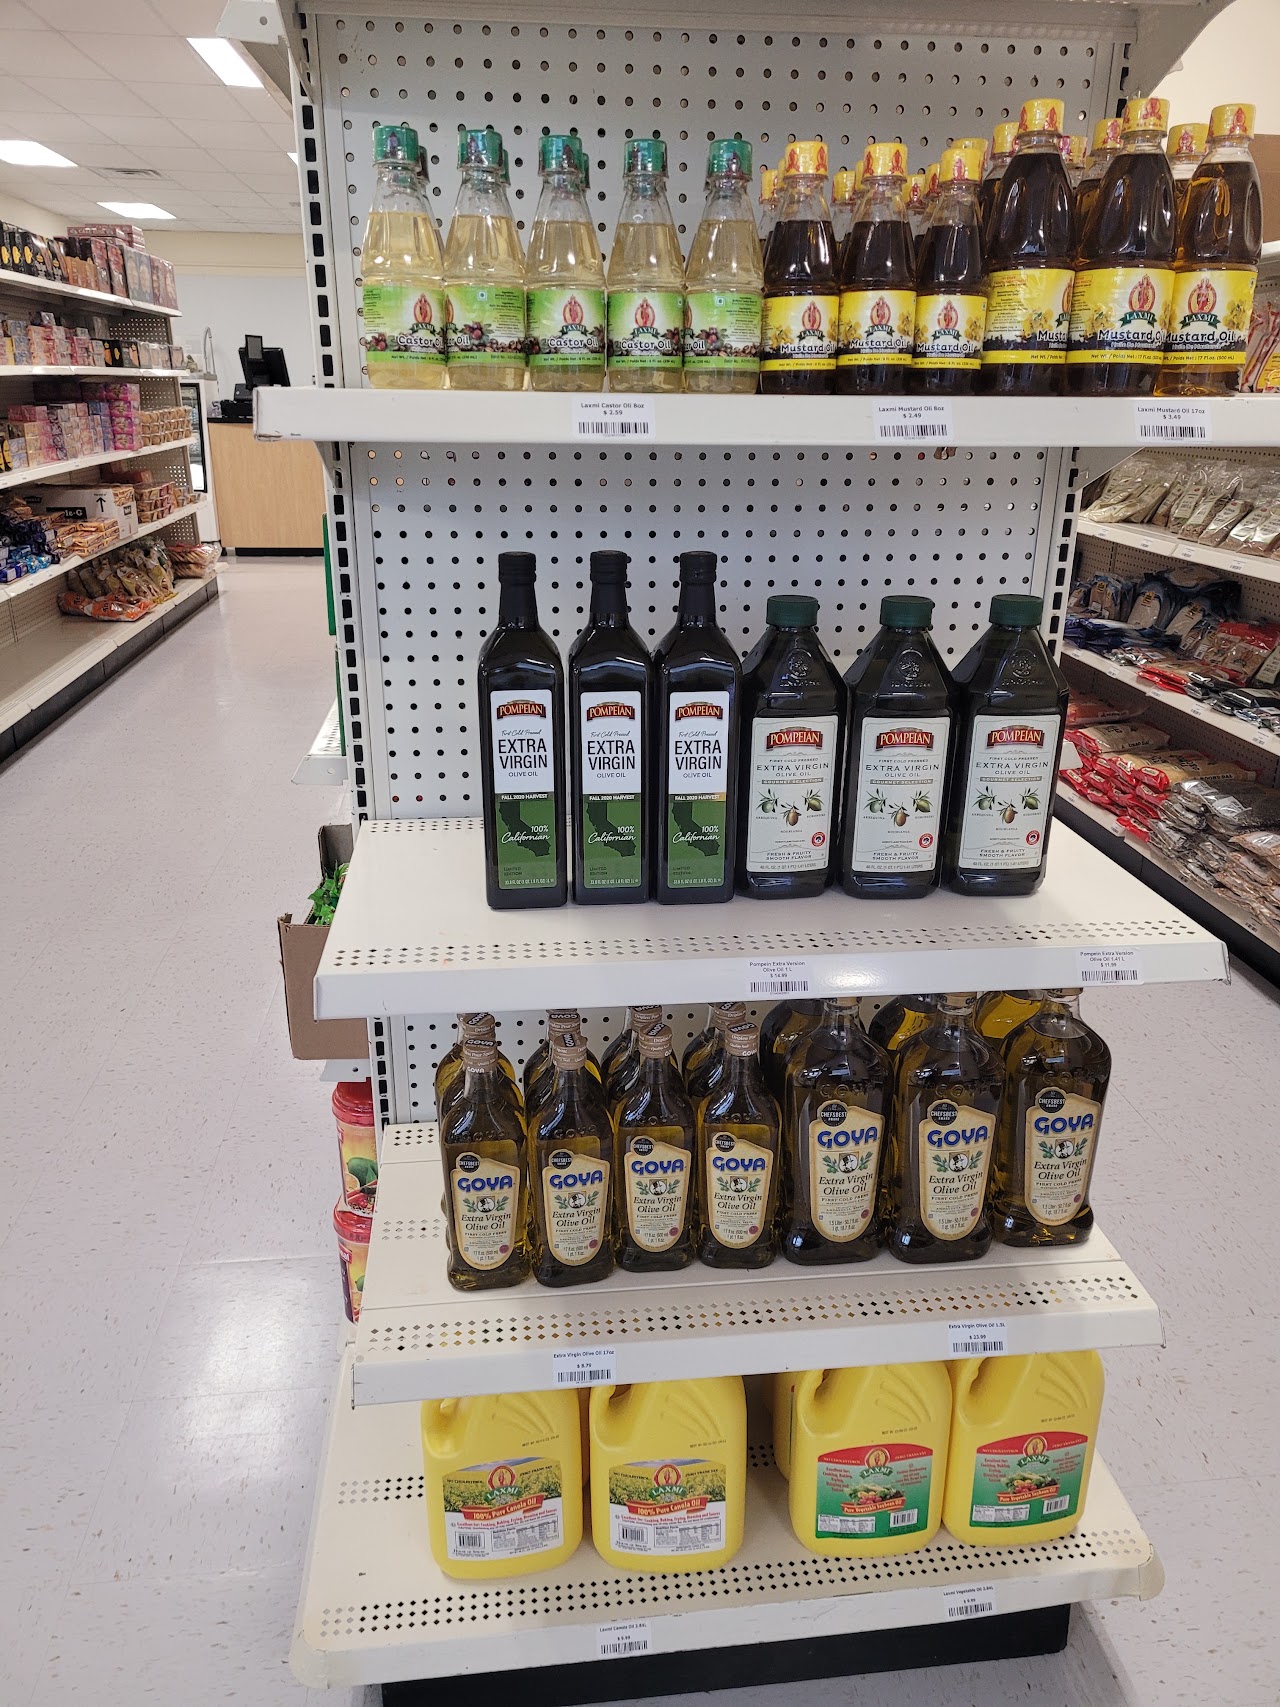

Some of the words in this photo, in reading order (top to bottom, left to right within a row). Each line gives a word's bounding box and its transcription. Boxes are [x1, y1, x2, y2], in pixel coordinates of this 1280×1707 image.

[1126, 312, 1154, 321] LAXMI
[1185, 314, 1215, 323] LAXMI
[413, 323, 434, 332] LAXMI
[562, 324, 585, 332] LAXMI
[634, 327, 657, 335] LAXMI
[869, 325, 891, 333] LAXMI
[936, 329, 958, 337] LAXMI
[801, 330, 822, 338] LAXMI
[1098, 329, 1153, 341] Mustard
[1219, 330, 1235, 342] Oil
[398, 335, 433, 347] Castor
[456, 335, 471, 346] Oil
[549, 337, 584, 348] Castor
[586, 337, 598, 348] Oil
[621, 340, 655, 350] Castor
[657, 340, 671, 350] Oil
[692, 340, 705, 350] Oil
[850, 338, 893, 348] Mustard
[895, 338, 907, 348] Oil
[781, 343, 824, 353] Mustard
[917, 343, 959, 352] Mustard
[961, 343, 975, 352] Oil
[499, 703, 543, 716] POMPEIAN
[589, 705, 632, 717] POMPEIAN
[678, 705, 721, 717] POMPEIAN
[770, 731, 820, 745] POMPEIAN
[880, 732, 931, 746] POMPEIAN
[991, 730, 1042, 743] POMPEIAN
[498, 738, 547, 754] EXTRA
[587, 739, 635, 755] EXTRA
[674, 739, 722, 755] EXTRA
[499, 754, 548, 769] VIRGIN
[588, 755, 636, 770] VIRGIN
[675, 755, 722, 770] VIRGIN
[794, 763, 830, 771] VIRGIN
[904, 763, 940, 771] VIRGIN
[976, 761, 1011, 769] EXTRA
[1014, 761, 1049, 769] VIRGIN
[531, 825, 549, 833] 100%
[617, 825, 635, 834] 100%
[702, 825, 719, 834] 100%
[501, 831, 551, 844] Californian
[588, 832, 636, 845] Californian
[672, 832, 720, 845] Californian
[1034, 1113, 1094, 1134] GOYA
[817, 1126, 878, 1149] GOYA
[927, 1125, 988, 1148] GOYA
[631, 1158, 684, 1176] GOYA
[712, 1156, 766, 1172] GOYA
[1034, 1160, 1060, 1170] Extra
[1062, 1158, 1088, 1170] Virgin
[549, 1169, 603, 1190] GOYA
[818, 1176, 845, 1185] Extra
[846, 1172, 874, 1185] Virgin
[929, 1174, 955, 1184] Extra
[956, 1171, 983, 1183] Virgin
[1038, 1171, 1065, 1180] Olive
[1066, 1168, 1081, 1179] Oil
[457, 1175, 513, 1193] GOYA
[823, 1186, 850, 1196] Olive
[851, 1183, 867, 1193] Oil
[933, 1184, 960, 1195] Olive
[961, 1181, 977, 1192] Oil
[1020, 1454, 1047, 1465] LAXMI
[862, 1466, 891, 1477] LAXMI
[486, 1486, 519, 1500] LAXMI
[652, 1485, 684, 1496] LAXMI
[473, 1511, 491, 1520] 100%
[491, 1509, 506, 1518] Pure
[506, 1502, 526, 1515] Canola
[527, 1497, 537, 1507] Oil
[637, 1506, 655, 1515] 100%
[656, 1505, 670, 1515] Pure
[670, 1501, 691, 1512] Canola
[691, 1499, 701, 1507] Oil
